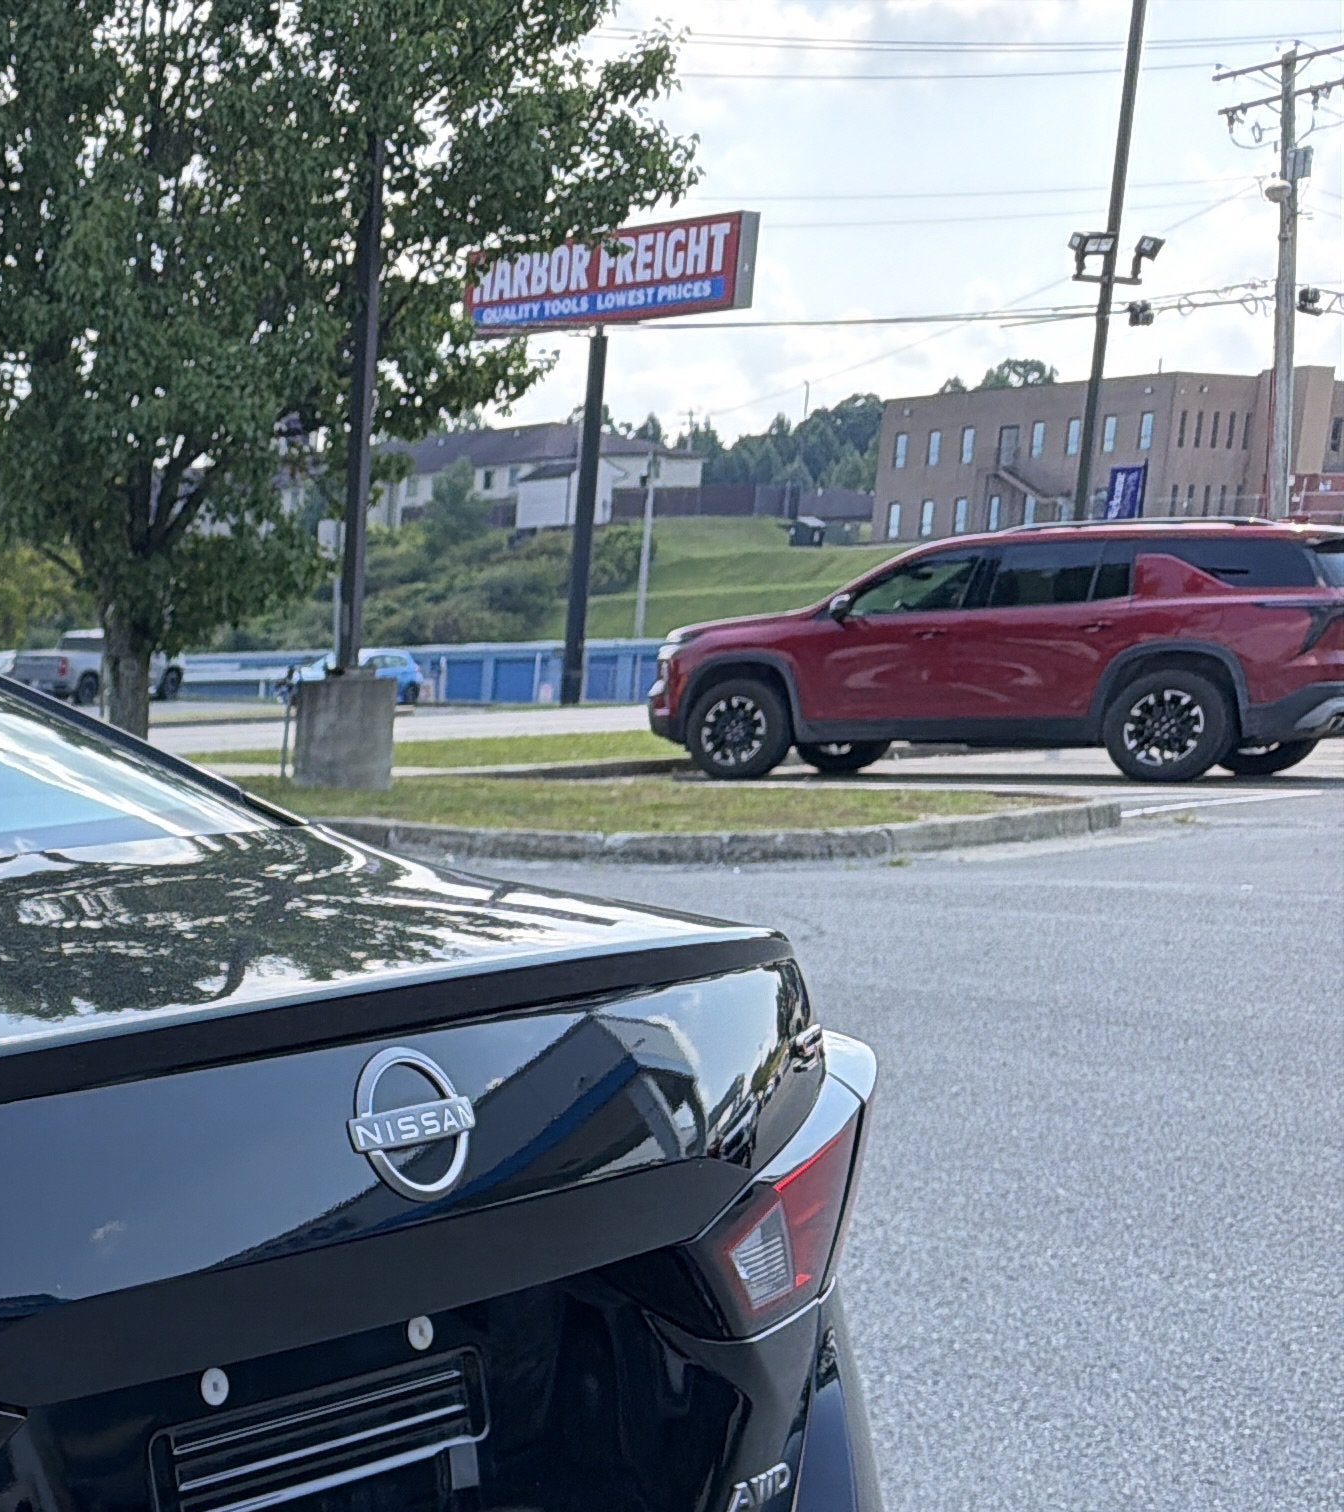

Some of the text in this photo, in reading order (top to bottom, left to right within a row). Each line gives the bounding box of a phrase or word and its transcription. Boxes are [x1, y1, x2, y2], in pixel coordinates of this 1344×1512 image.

[472, 222, 731, 304] HARBOR FREIGHT
[482, 280, 712, 324] QUALITY TOOLS LOWEST PRICES
[355, 1104, 475, 1148] NISSAN
